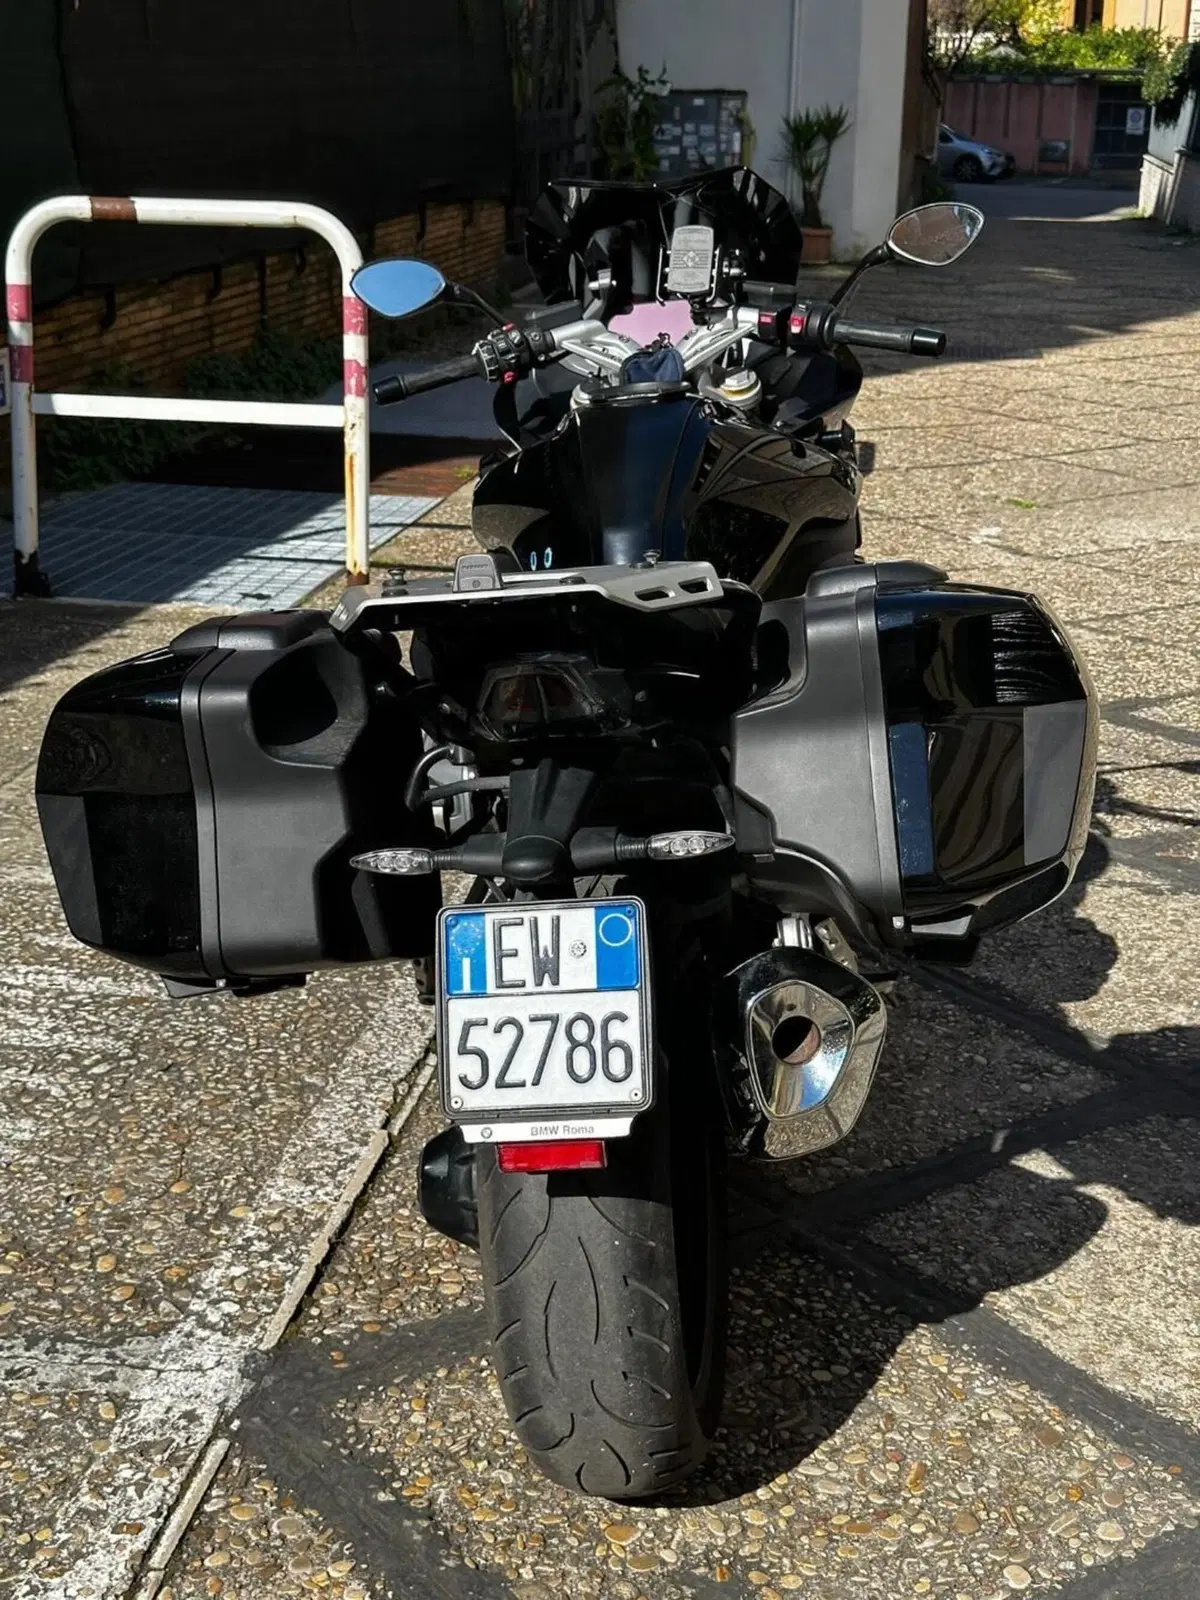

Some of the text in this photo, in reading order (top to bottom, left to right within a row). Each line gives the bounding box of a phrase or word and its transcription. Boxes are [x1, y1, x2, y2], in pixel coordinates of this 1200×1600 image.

[492, 914, 561, 989] EW
[457, 1011, 633, 1090] 52786
[530, 1124, 595, 1137] BMW Roma
